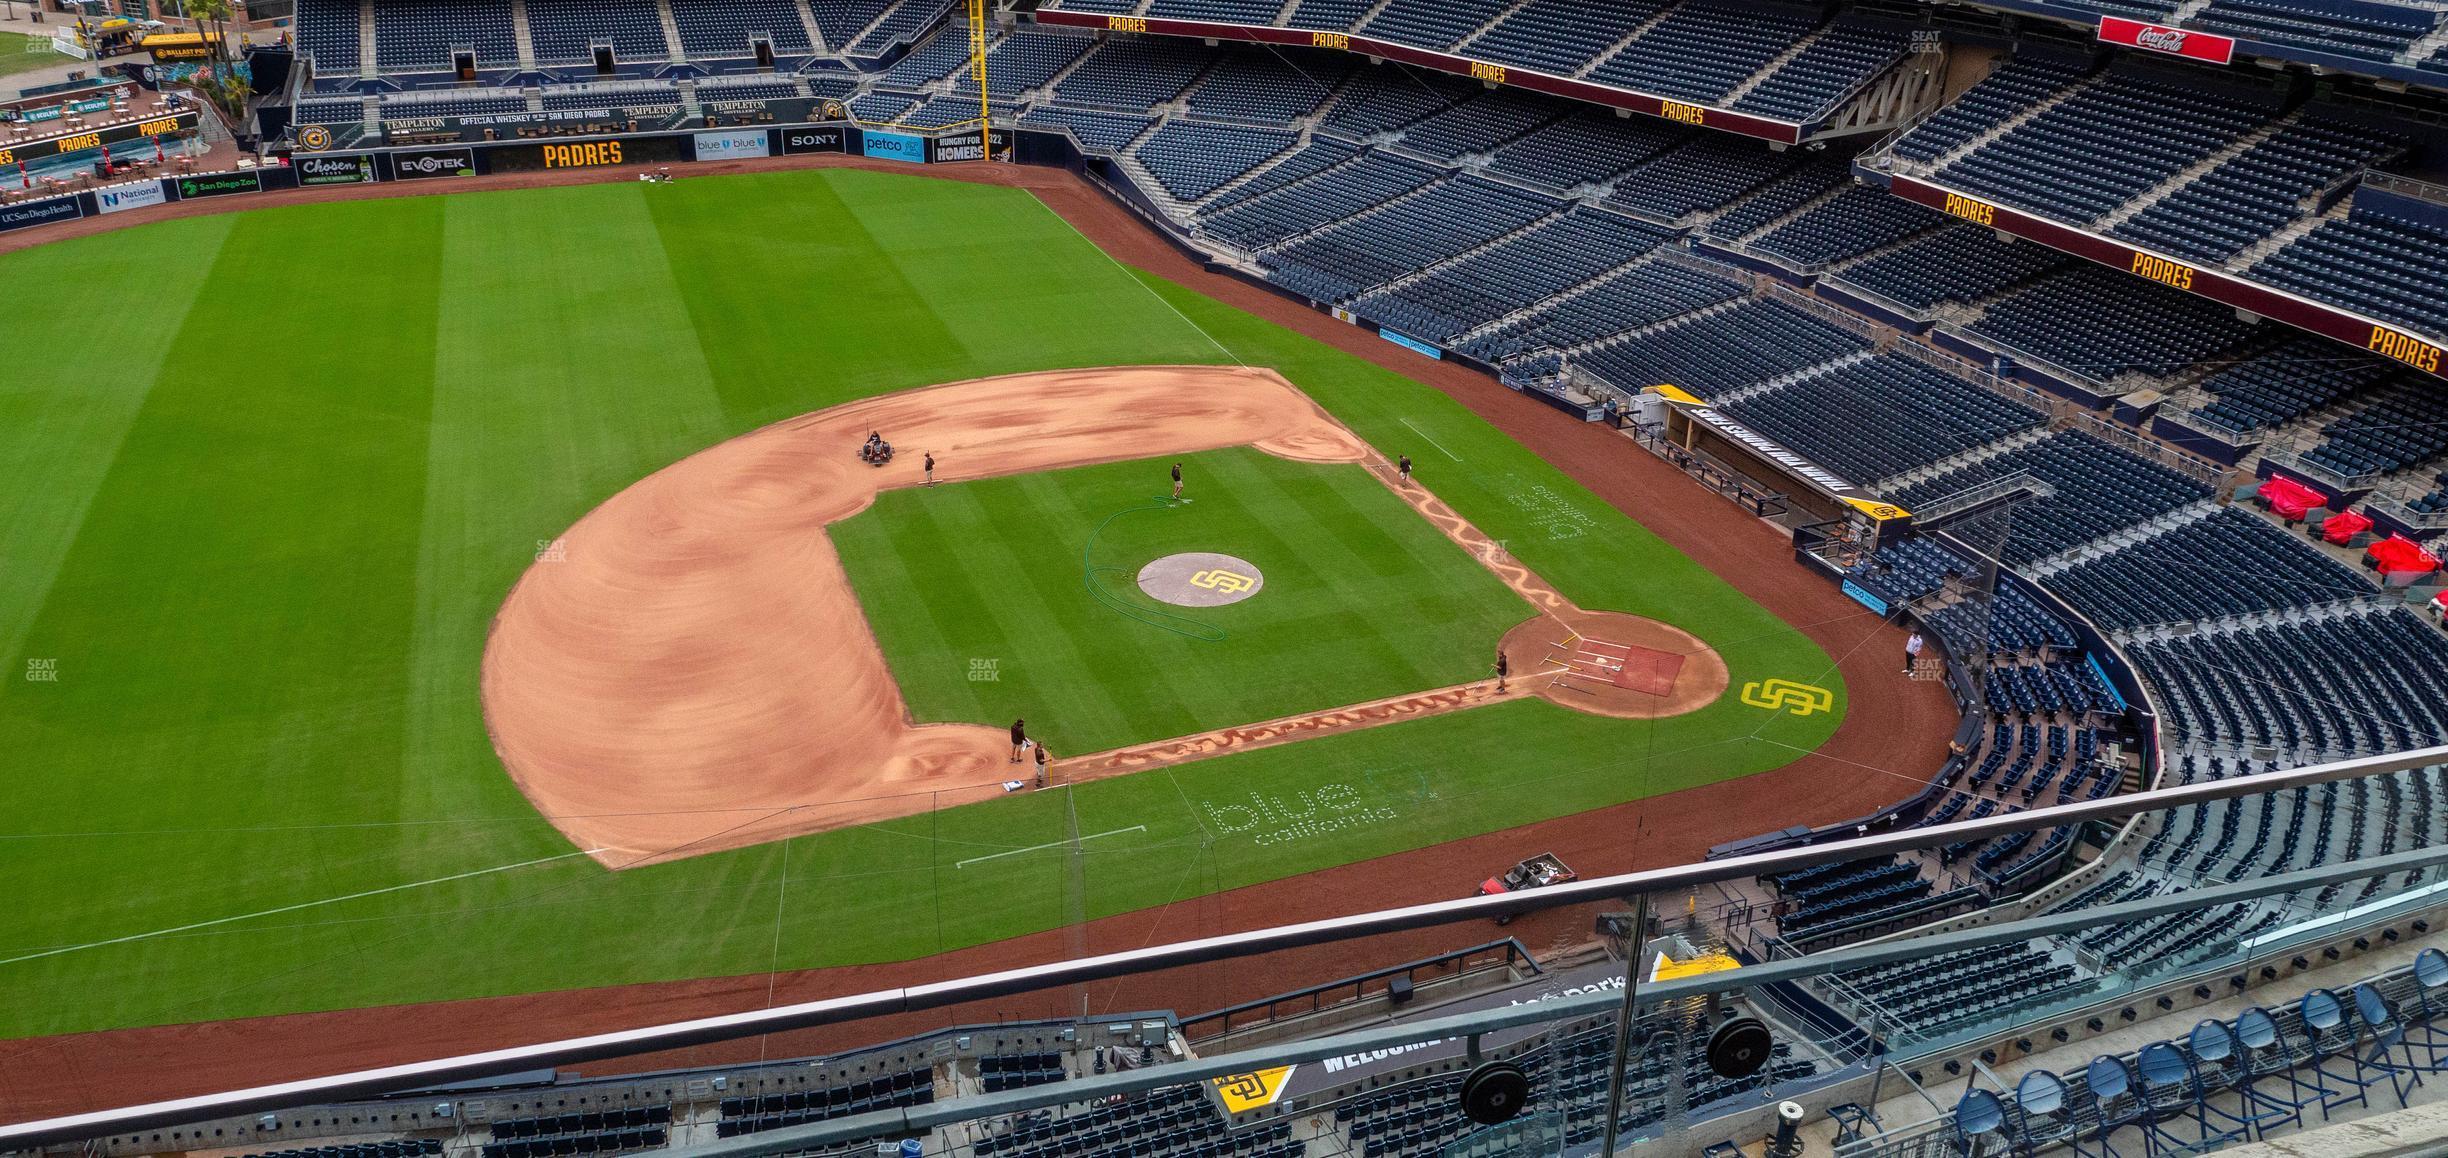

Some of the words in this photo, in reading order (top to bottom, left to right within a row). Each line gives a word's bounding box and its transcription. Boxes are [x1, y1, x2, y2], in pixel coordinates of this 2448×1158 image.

[1109, 17, 1146, 32] PADRES
[1312, 32, 1349, 50] PADRES
[1471, 61, 1505, 83] PADRES
[623, 105, 679, 117] TEMPLETON
[712, 101, 766, 112] TEMPLETON
[1661, 100, 1704, 126] PADRES
[384, 118, 446, 130] TEMPLETON
[460, 117, 495, 126] OFFICIAL
[496, 114, 531, 123] WHISKEY
[549, 111, 563, 120] SAN
[564, 111, 583, 119] DIEGO
[585, 109, 610, 118] PADRES
[139, 118, 178, 137] PADRES
[58, 133, 100, 153] PADRES
[698, 141, 721, 150] blue
[733, 139, 756, 148] blue
[791, 134, 838, 146] SONY
[867, 137, 902, 152] petco
[940, 138, 967, 146] HUNGRY
[967, 136, 981, 145] FOR
[988, 133, 1003, 145] 322
[543, 140, 623, 168] PADRES
[937, 145, 984, 161] HOMERS
[303, 159, 356, 174] Chosen
[401, 157, 465, 172] EVOTEK
[120, 185, 159, 199] National
[200, 181, 216, 190] San
[216, 180, 240, 190] Diego
[240, 178, 257, 186] Zoo
[2, 213, 14, 223] UC
[15, 212, 29, 220] San
[29, 208, 50, 218] Diego
[49, 204, 74, 215] Health
[1945, 193, 1994, 226] PADRES
[2131, 251, 2194, 290] PADRES
[2368, 325, 2439, 373] PADRES
[1844, 583, 1865, 599] petco
[1202, 784, 1361, 834] blue
[1255, 806, 1397, 846] california
